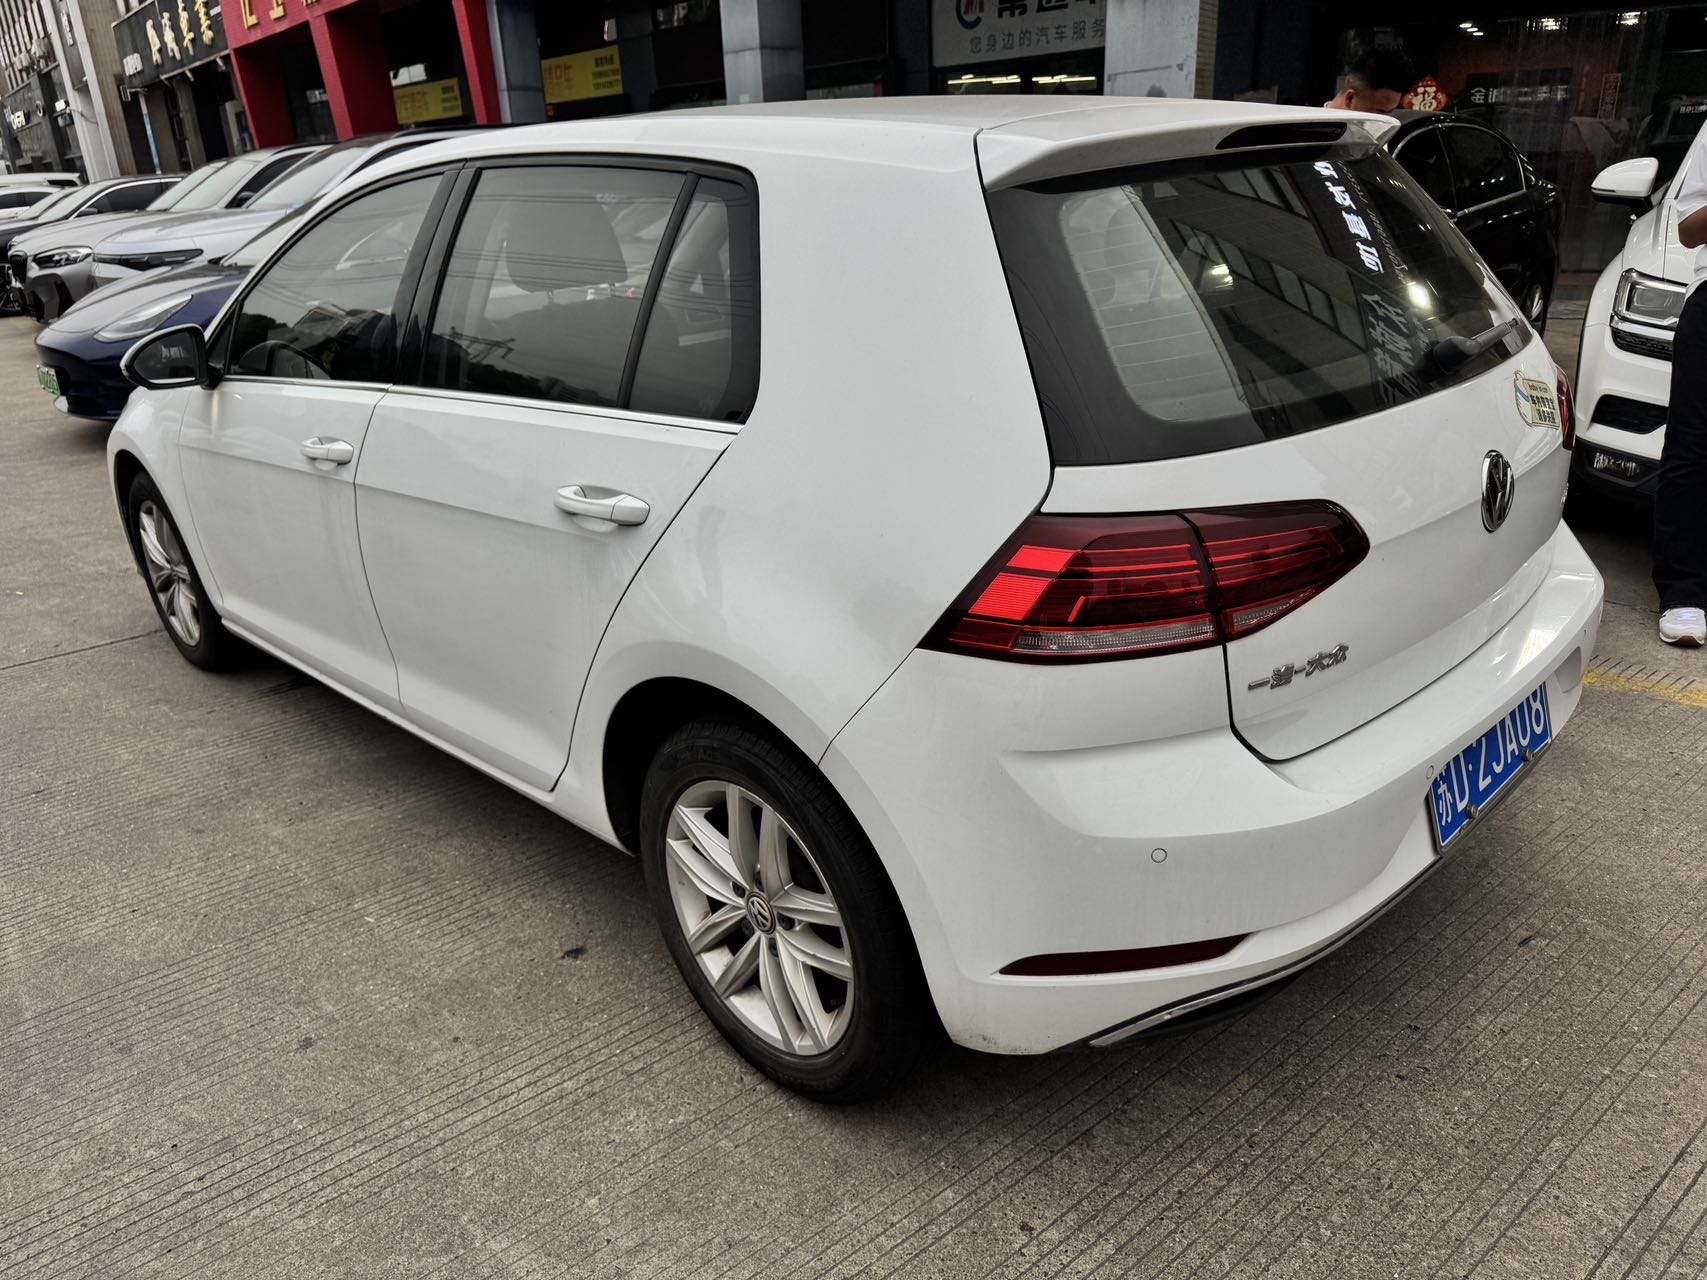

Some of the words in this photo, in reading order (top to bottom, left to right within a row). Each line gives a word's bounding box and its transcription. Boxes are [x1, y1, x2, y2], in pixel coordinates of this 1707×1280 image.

[969, 18, 1105, 54] 您身边的汽车服务
